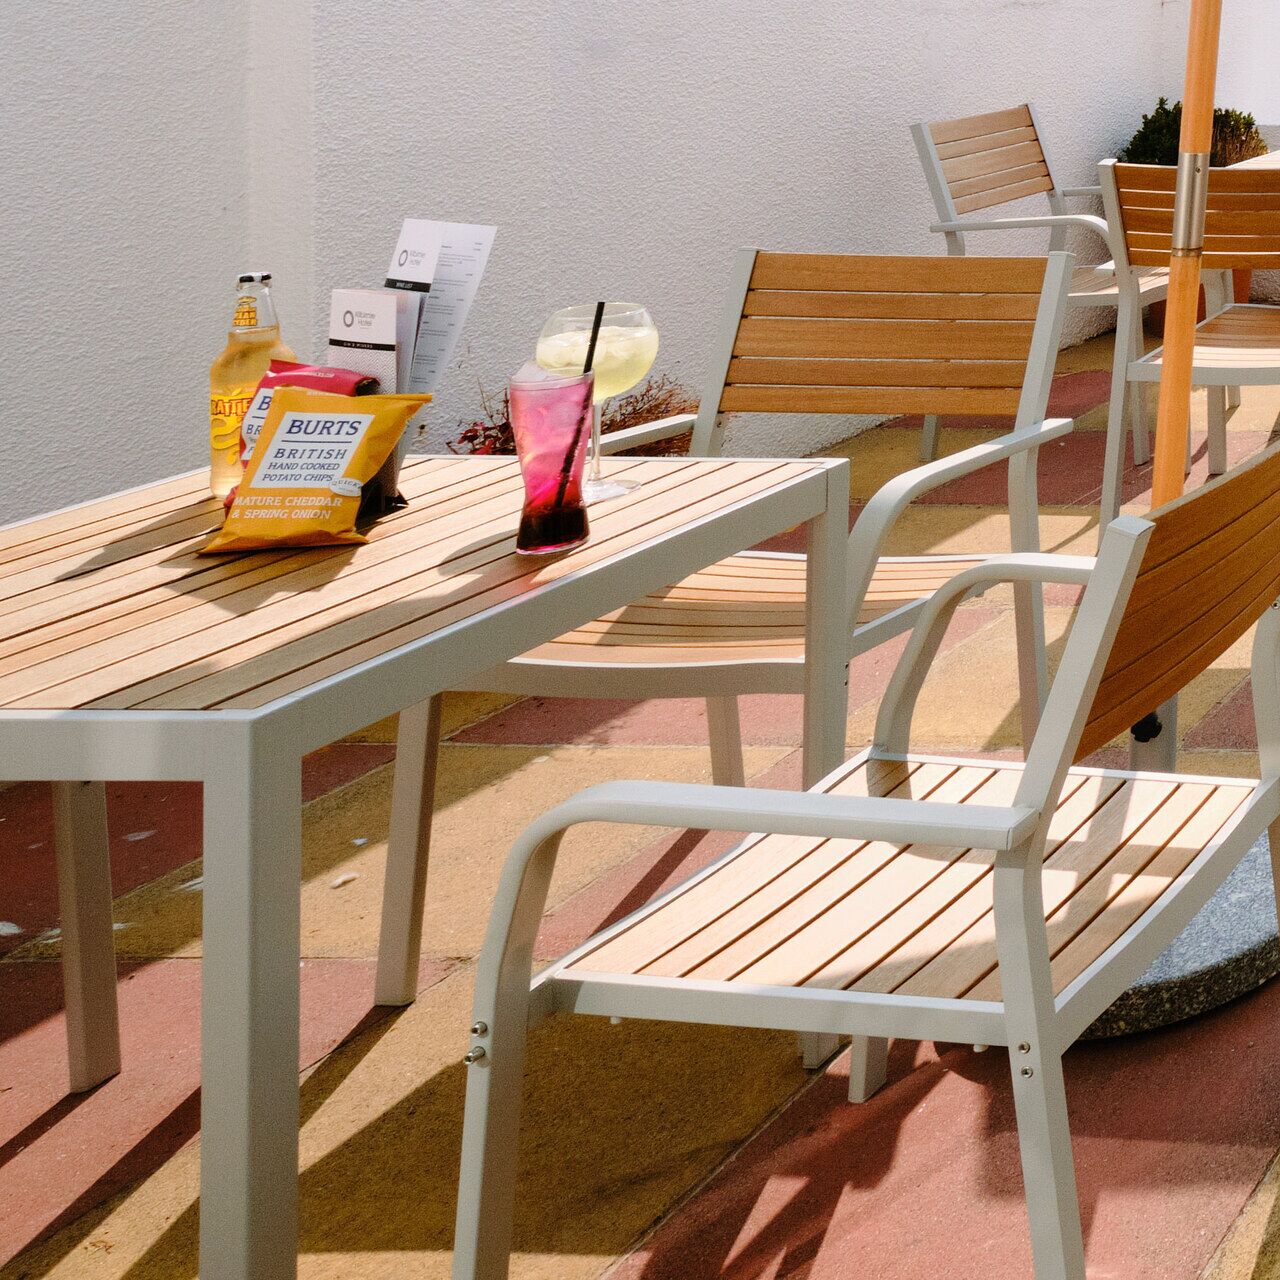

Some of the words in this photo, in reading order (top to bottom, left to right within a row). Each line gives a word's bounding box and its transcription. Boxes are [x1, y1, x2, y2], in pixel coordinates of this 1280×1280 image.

[211, 397, 253, 417] RATTLE
[286, 419, 362, 436] BURTS
[273, 448, 348, 460] BRITISH
[267, 462, 299, 470] HAND
[300, 462, 340, 470] COOKED
[262, 473, 302, 482] POTATO
[303, 473, 334, 482] CHIPS
[233, 496, 283, 506] MATURE
[285, 496, 343, 507] CHEDDAR
[231, 509, 239, 518] &
[244, 509, 289, 519] SPRING
[291, 509, 332, 519] ONION
